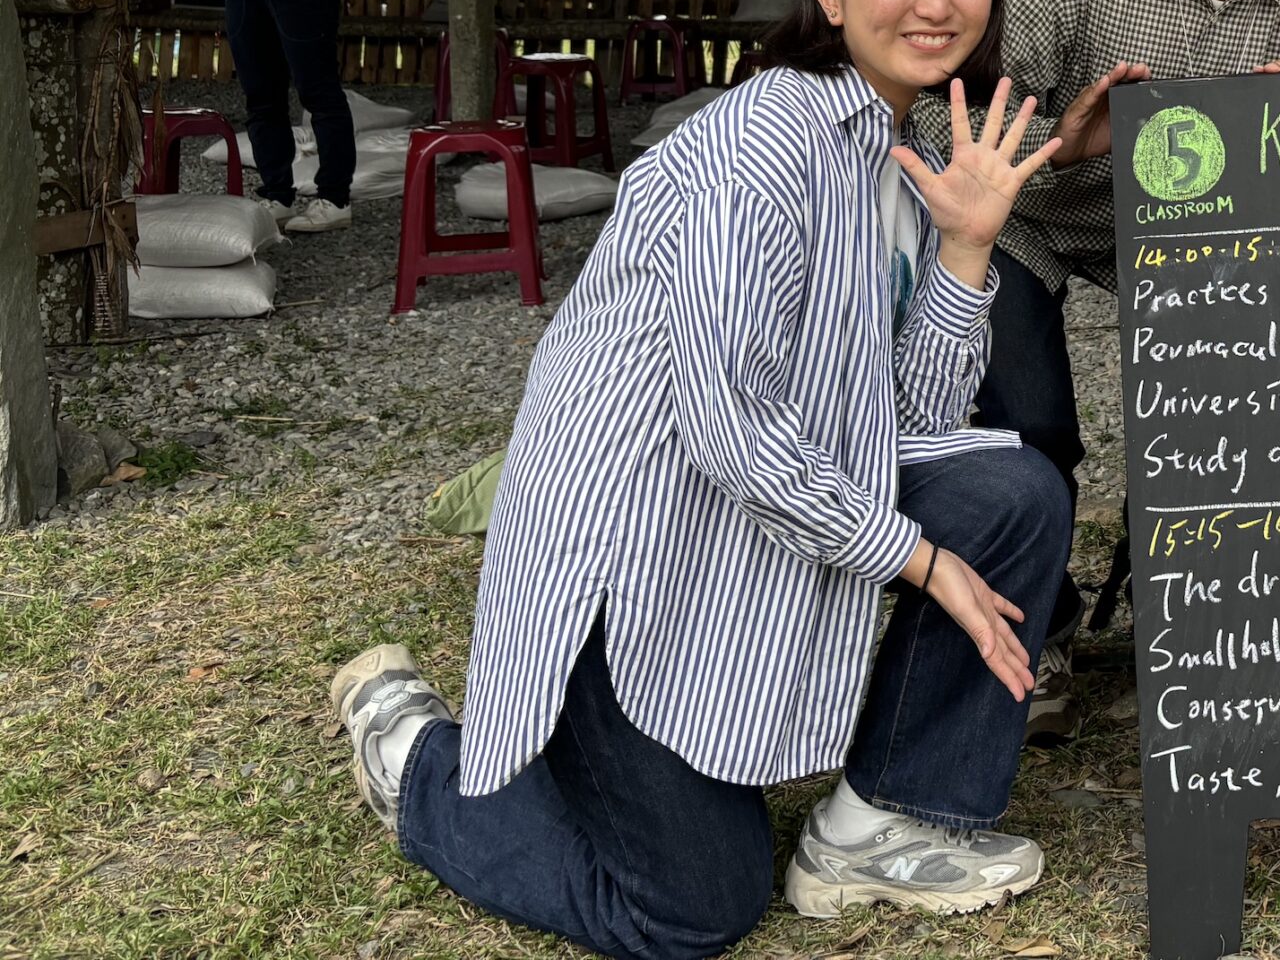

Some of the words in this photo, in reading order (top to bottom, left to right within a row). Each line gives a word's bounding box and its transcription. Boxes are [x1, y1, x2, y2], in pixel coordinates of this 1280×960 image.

[1166, 120, 1202, 190] 5
[1135, 194, 1235, 225] CLASSROOM
[1133, 279, 1268, 313] Practices
[1144, 432, 1248, 494] Study
[1149, 569, 1222, 622] The
